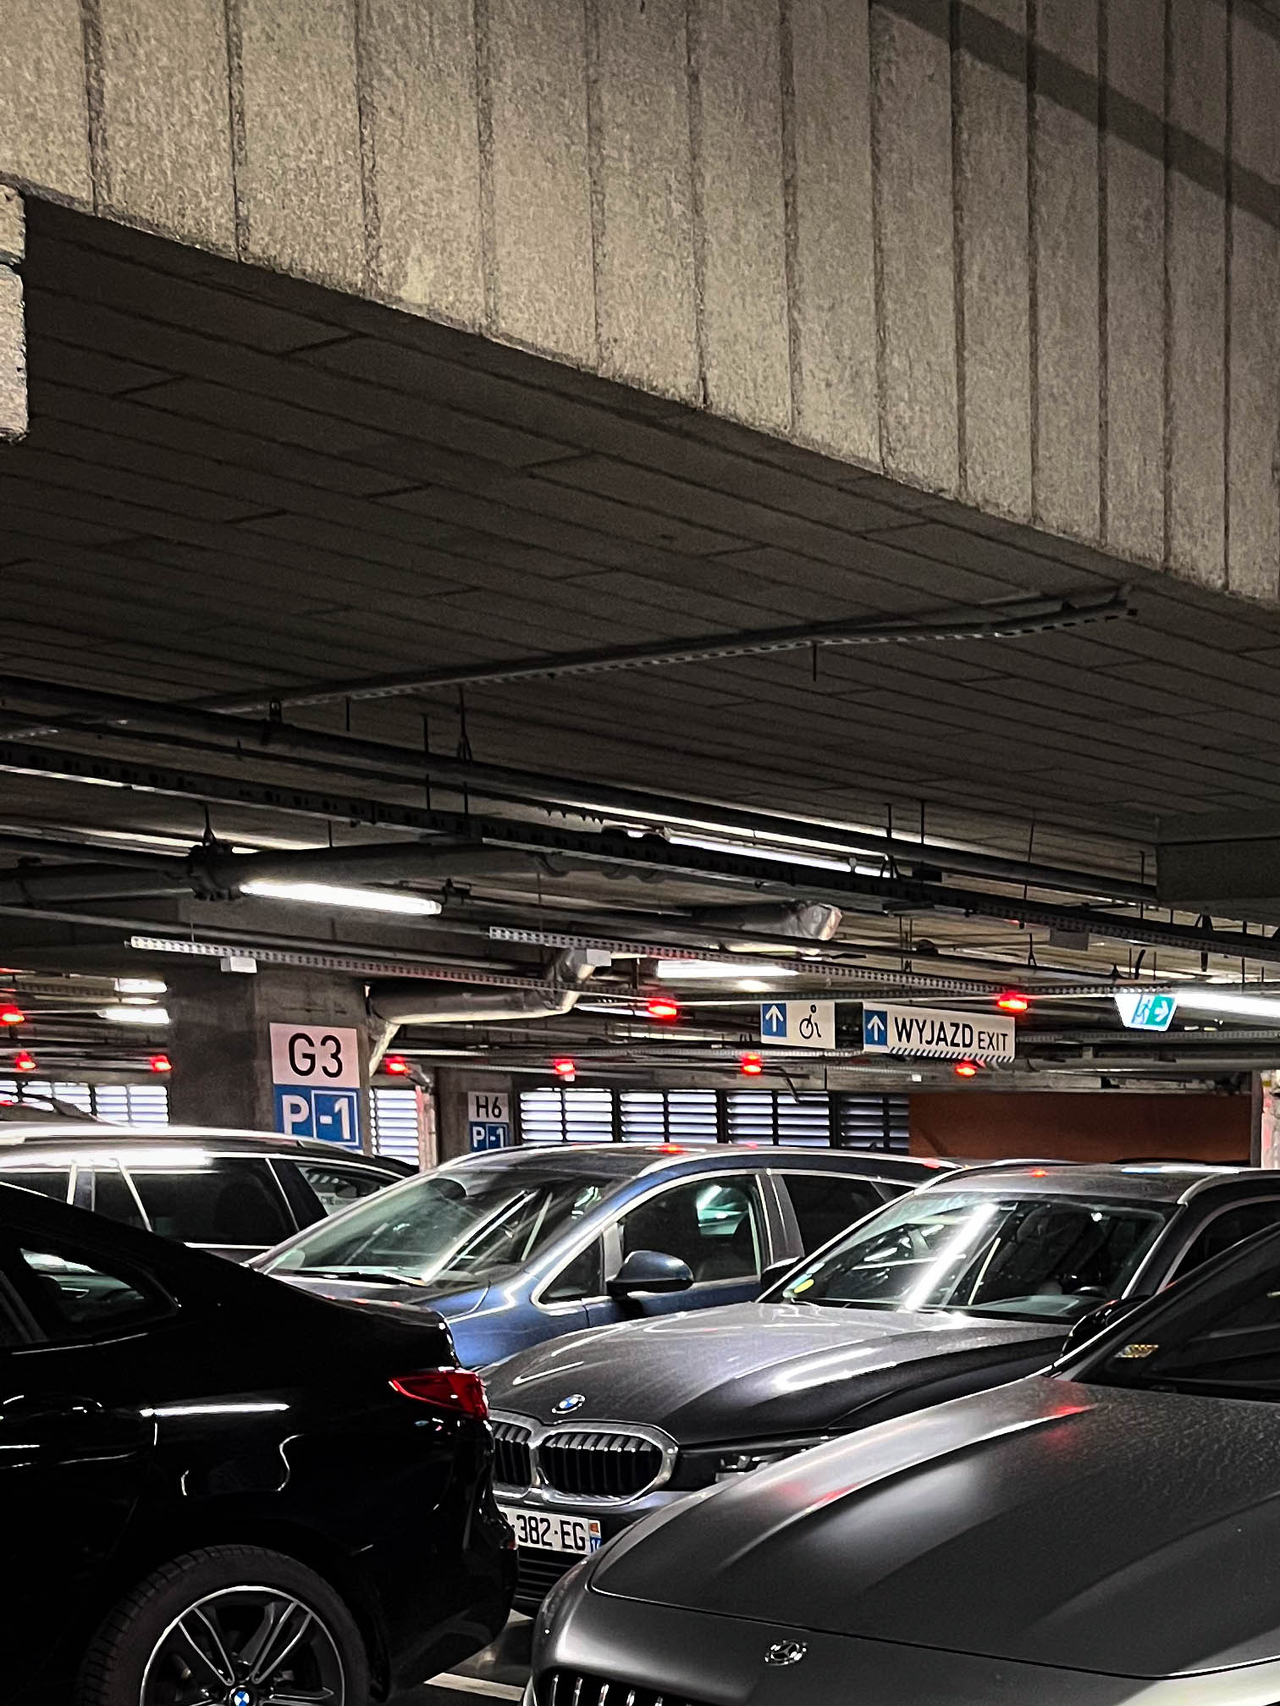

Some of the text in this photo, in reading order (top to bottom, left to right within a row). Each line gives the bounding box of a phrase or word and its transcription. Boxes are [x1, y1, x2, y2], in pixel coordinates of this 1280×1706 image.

[894, 1016, 1009, 1051] WYJAZD EXIT
[288, 1032, 344, 1078] G3
[476, 1095, 502, 1118] H6
